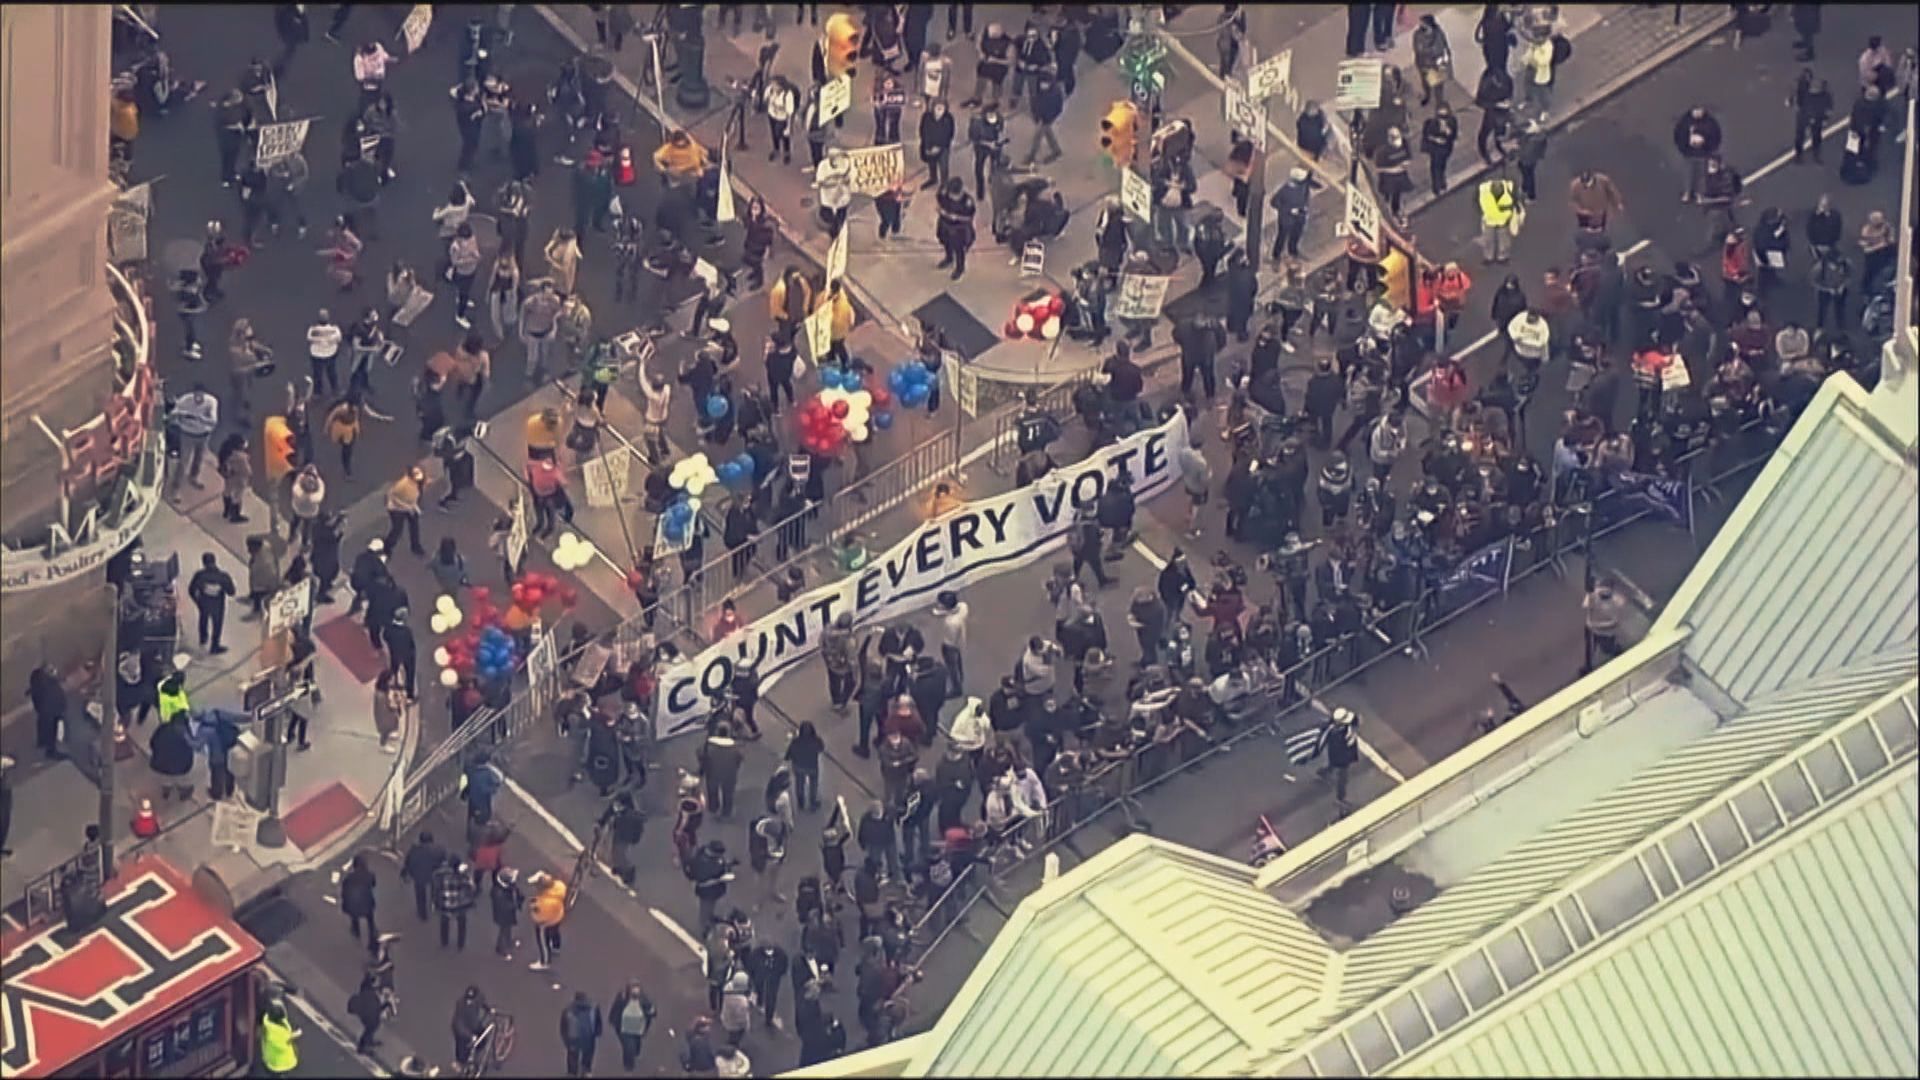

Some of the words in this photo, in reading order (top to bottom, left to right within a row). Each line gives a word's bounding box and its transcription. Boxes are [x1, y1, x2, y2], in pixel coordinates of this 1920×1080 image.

[667, 592, 841, 714] COUNT
[855, 502, 1015, 613] EVERY
[1033, 432, 1168, 524] VOTE
